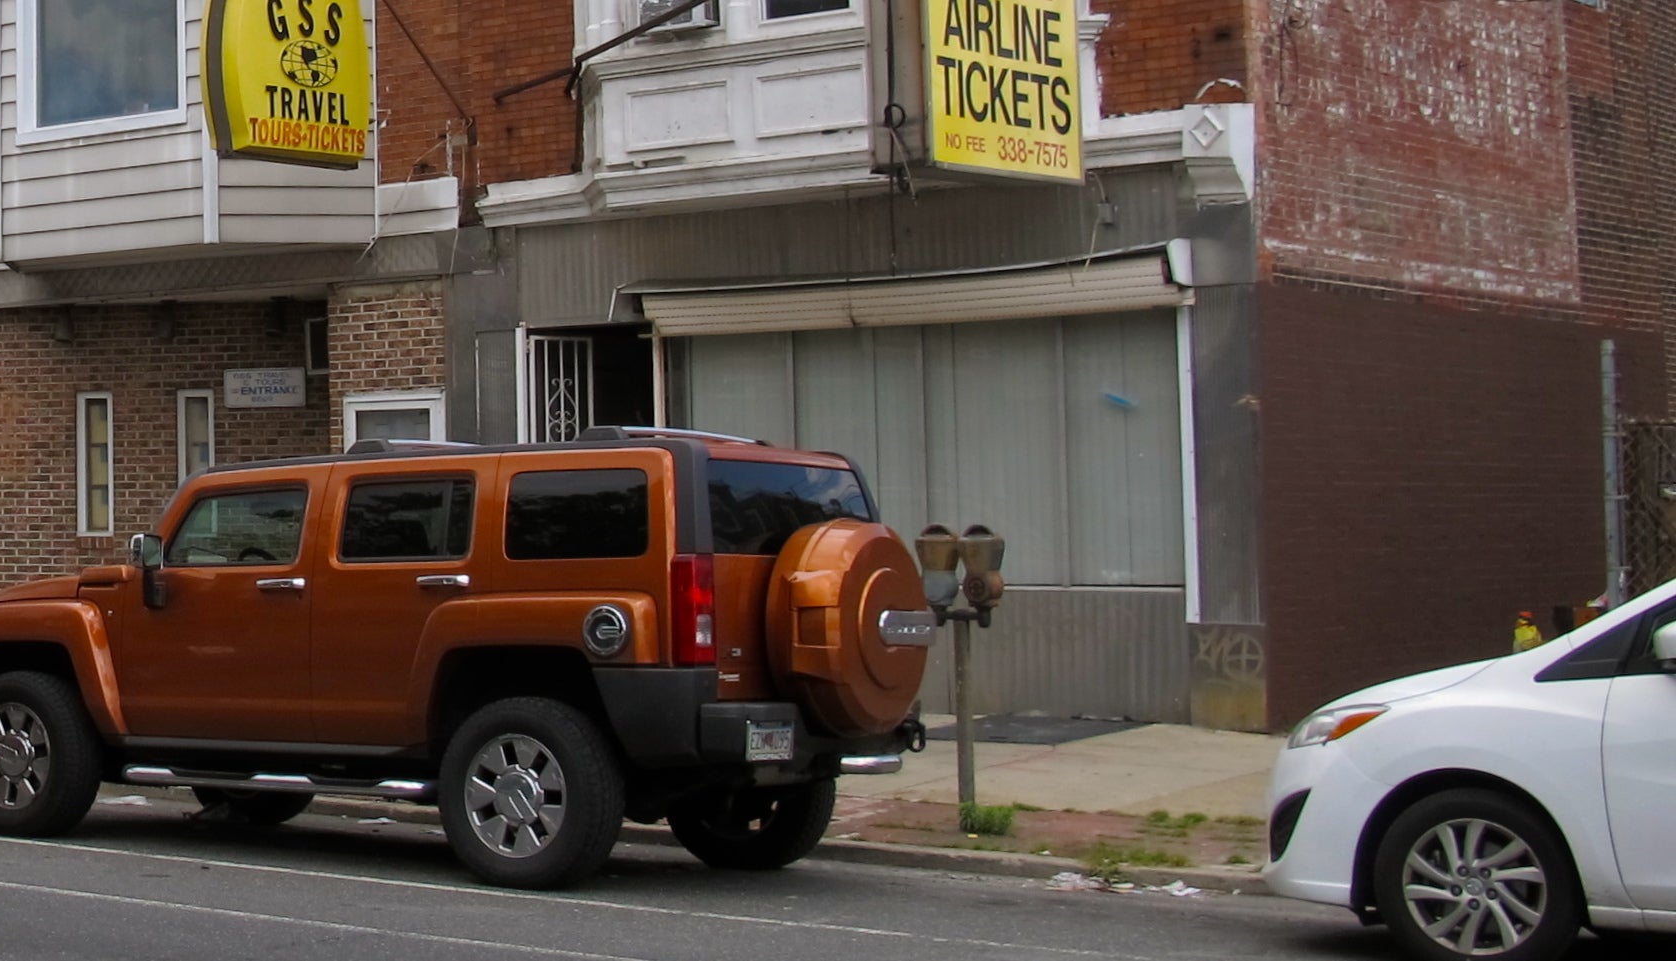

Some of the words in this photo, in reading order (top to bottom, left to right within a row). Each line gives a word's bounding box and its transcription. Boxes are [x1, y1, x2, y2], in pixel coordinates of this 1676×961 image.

[265, 85, 350, 126] TRAVEL
[936, 55, 1072, 136] TICKETS
[945, 132, 962, 150] NO
[966, 135, 987, 153] FEE
[996, 135, 1069, 169] 338-7575
